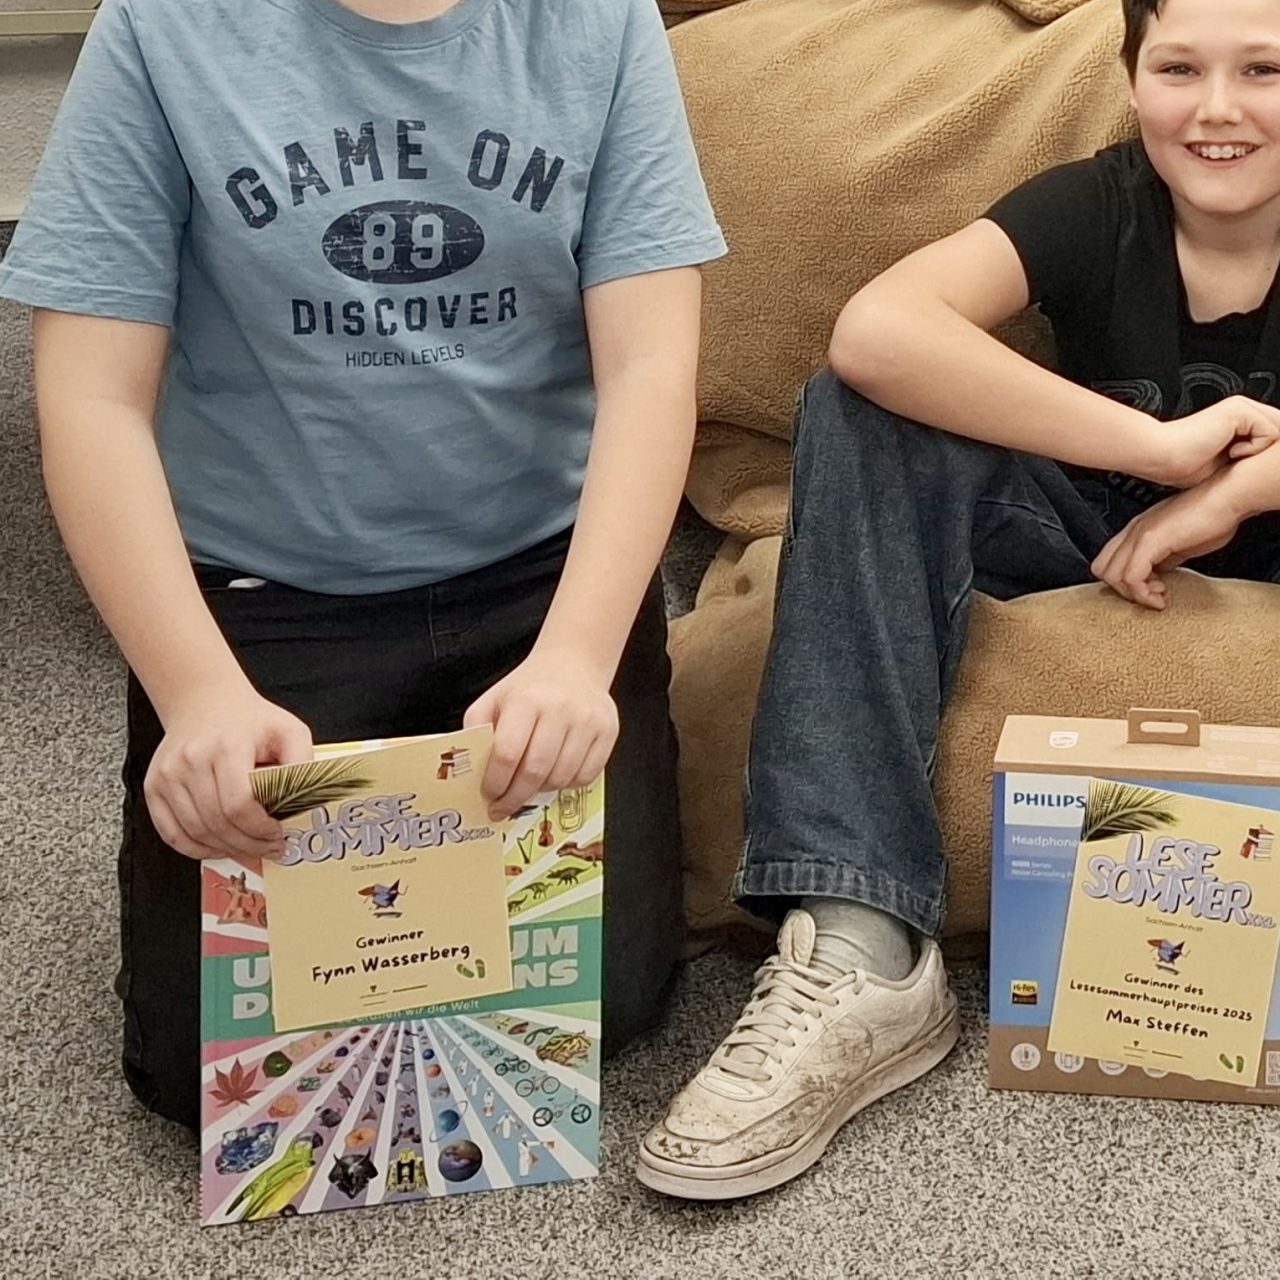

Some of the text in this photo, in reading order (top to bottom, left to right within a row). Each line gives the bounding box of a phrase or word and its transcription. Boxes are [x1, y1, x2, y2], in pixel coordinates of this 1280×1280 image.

[225, 119, 564, 230] GAME ON
[362, 212, 444, 271] 89
[291, 286, 518, 336] DISCOVER
[345, 343, 464, 367] HIDDEN LEVELS
[311, 792, 421, 831] LESE
[1012, 791, 1087, 809] PHILIPS
[277, 808, 462, 867] SOMMER
[1126, 831, 1221, 882] LESE
[1082, 854, 1252, 926] SOMMER
[356, 930, 425, 949] Gewinner
[312, 945, 470, 984] Fynn Wasserberg
[1124, 972, 1204, 996] Gewinner des
[450, 999, 480, 1011] Welt
[1069, 978, 1252, 1022] Lesesommerhauptpreises 2025
[1105, 1008, 1209, 1039] Max Steffen
